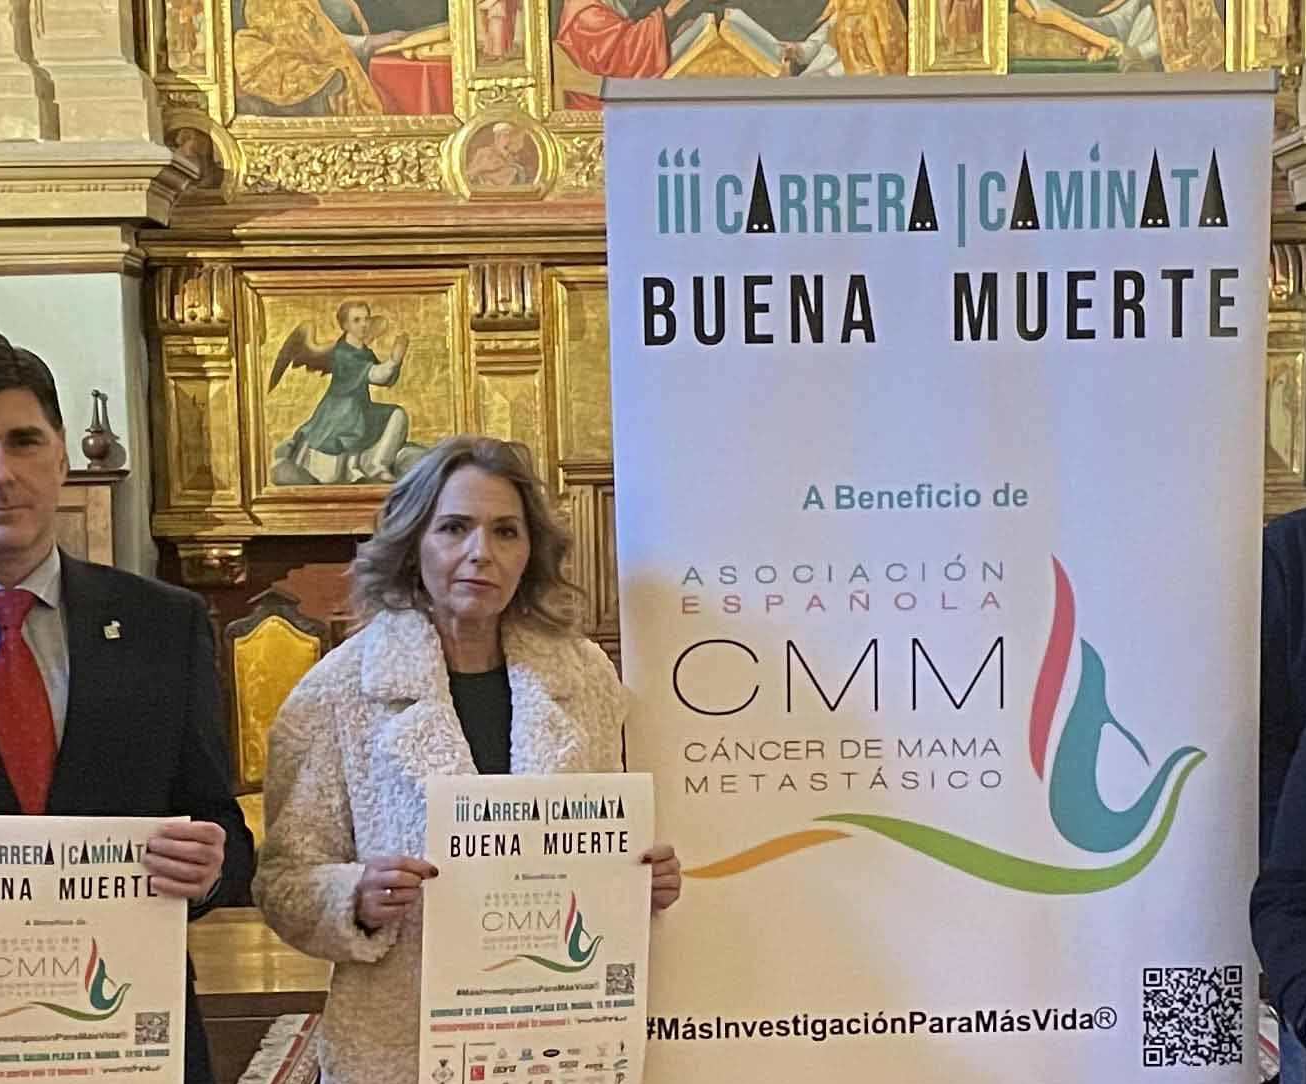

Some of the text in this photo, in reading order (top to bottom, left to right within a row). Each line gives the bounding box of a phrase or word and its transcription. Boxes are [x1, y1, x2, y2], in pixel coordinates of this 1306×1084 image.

[716, 152, 939, 234] CARRERA
[643, 268, 1239, 346] BUENA MUERTE
[803, 482, 1028, 510] A Beneficio de
[681, 554, 1005, 587] ASOCIACIÓN
[681, 590, 1001, 615] ESPAÑOLA
[673, 636, 1005, 716] CMM
[684, 737, 1001, 764] CÁNCER DE MAMA
[684, 767, 1002, 794] METASTÁSICO
[474, 796, 540, 822] CARRERA
[450, 831, 628, 857] BUENA MUERTE
[482, 909, 561, 932] CMM
